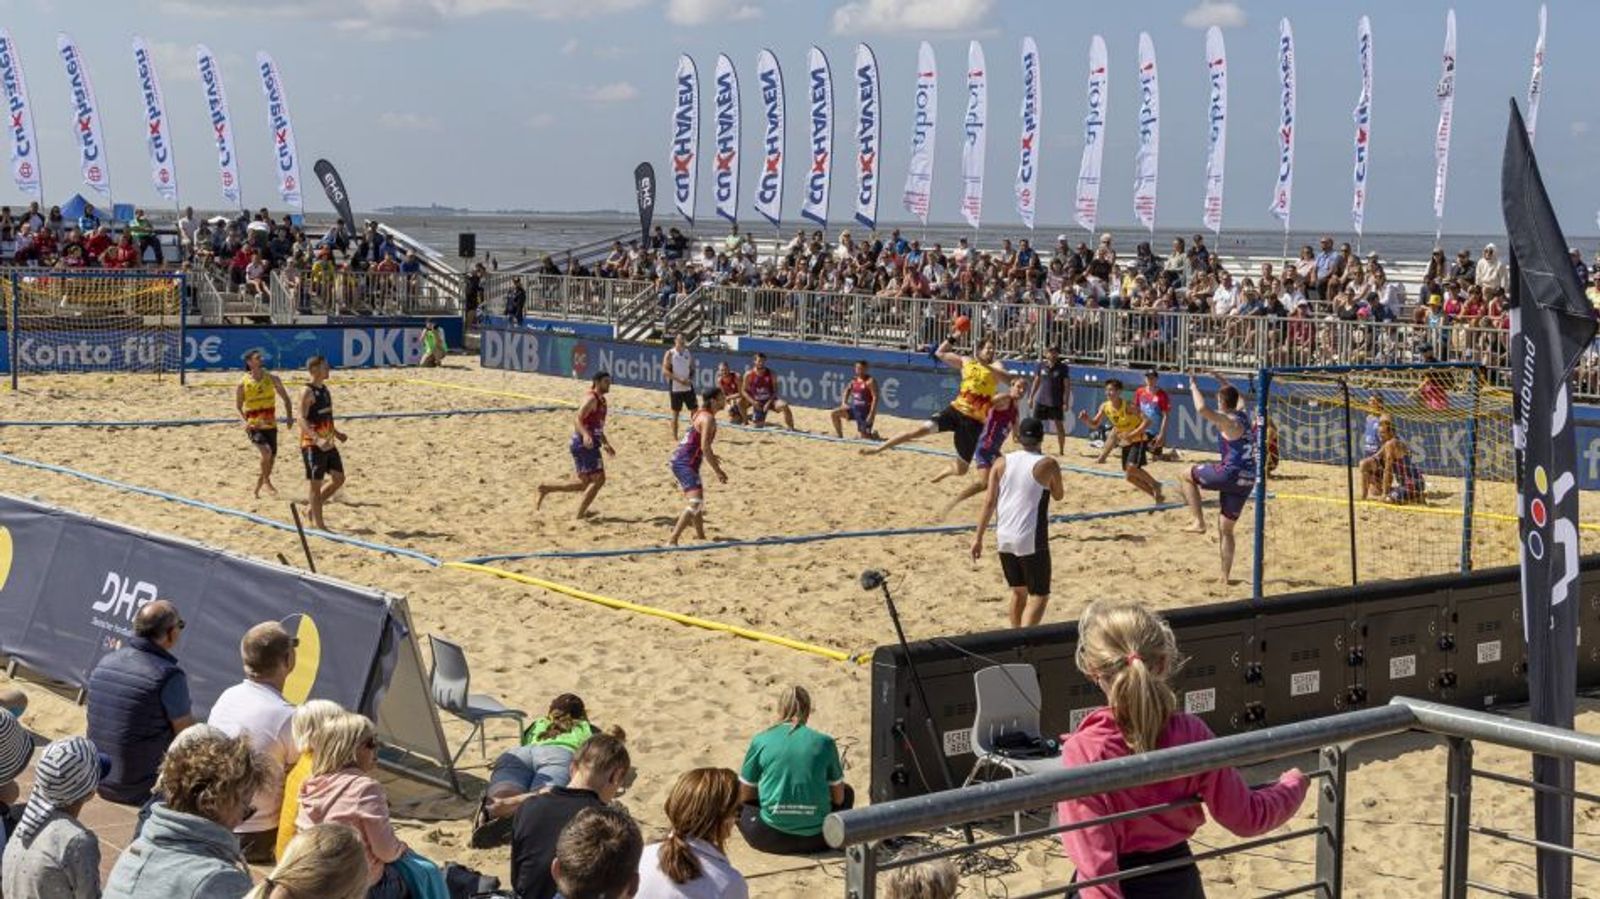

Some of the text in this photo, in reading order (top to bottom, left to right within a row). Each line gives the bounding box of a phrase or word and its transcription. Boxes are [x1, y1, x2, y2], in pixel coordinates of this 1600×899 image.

[18, 338, 112, 365] Konto
[485, 331, 539, 371] DKB
[946, 731, 971, 743] SCREE
